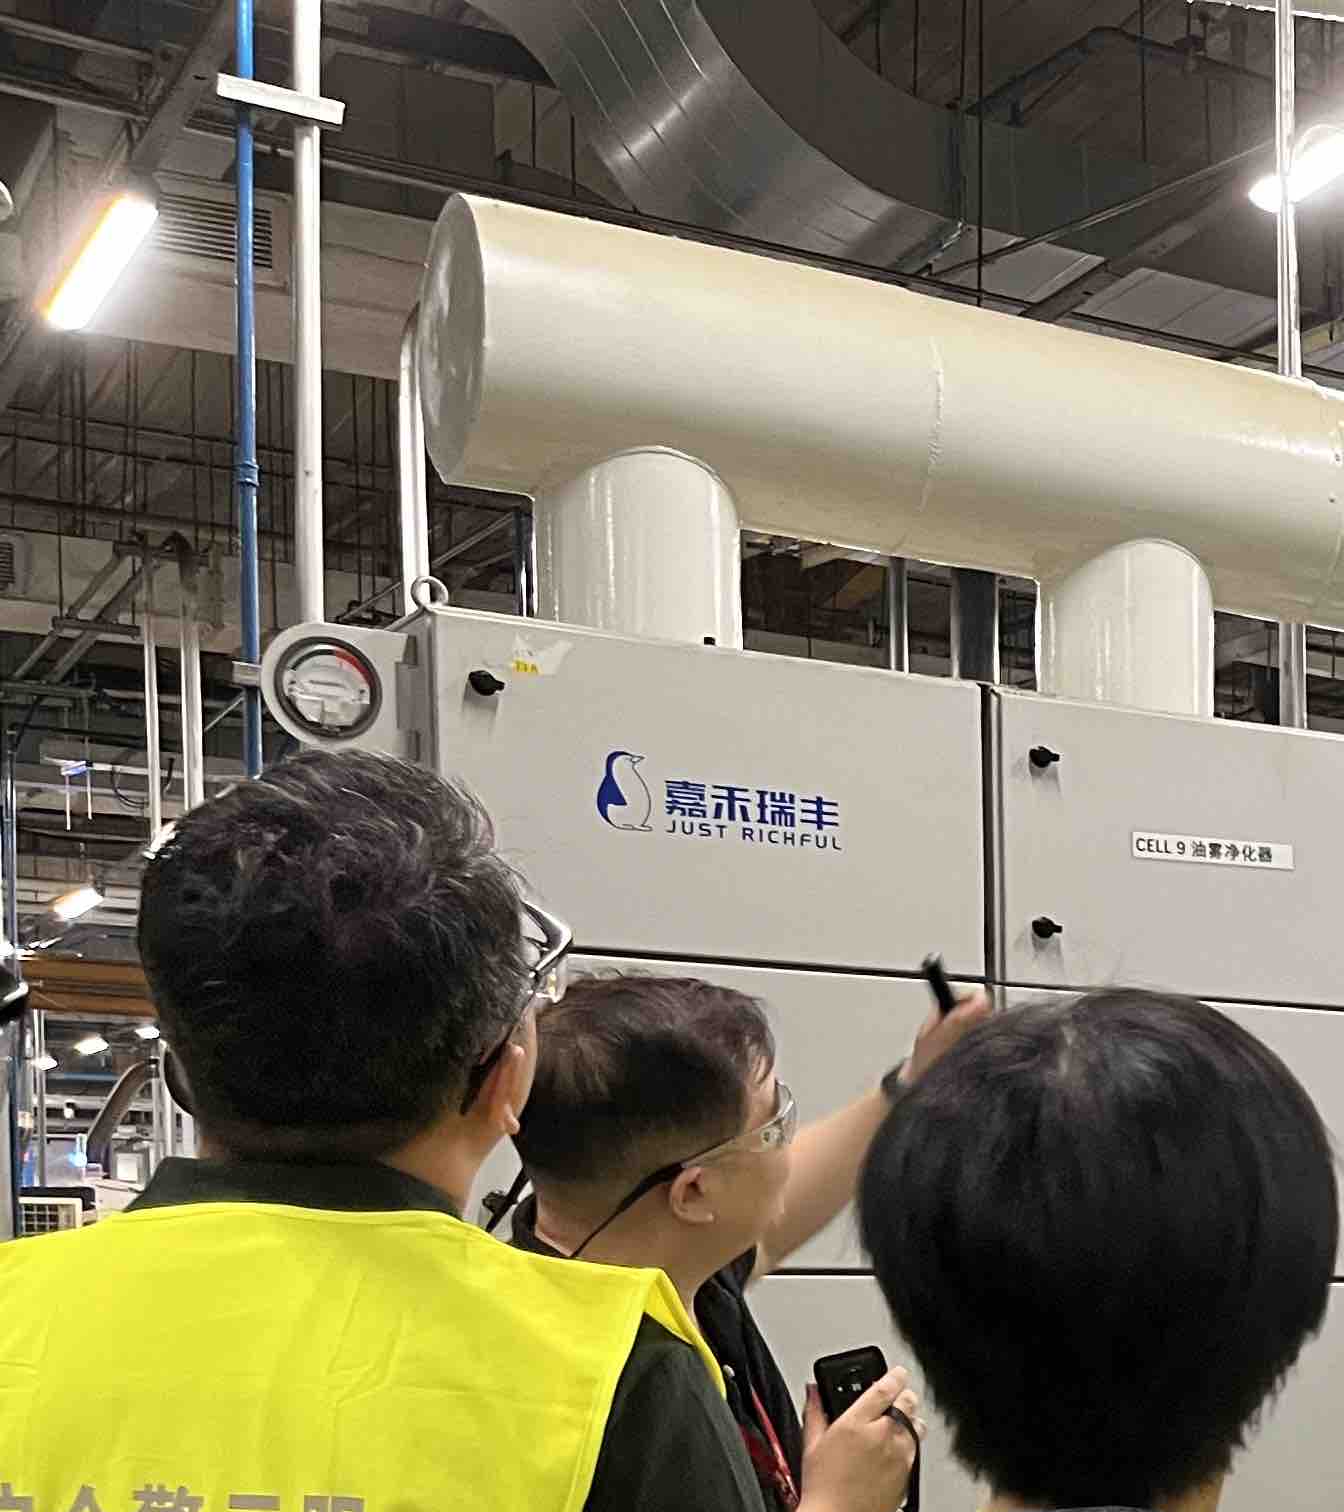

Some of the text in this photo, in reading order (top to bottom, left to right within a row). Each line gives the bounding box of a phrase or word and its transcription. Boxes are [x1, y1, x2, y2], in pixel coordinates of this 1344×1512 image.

[664, 779, 840, 831] 嘉禾瑞丰
[665, 819, 843, 851] JUST RICHFUL
[1135, 837, 1273, 863] CELL 9 油雾净化器
